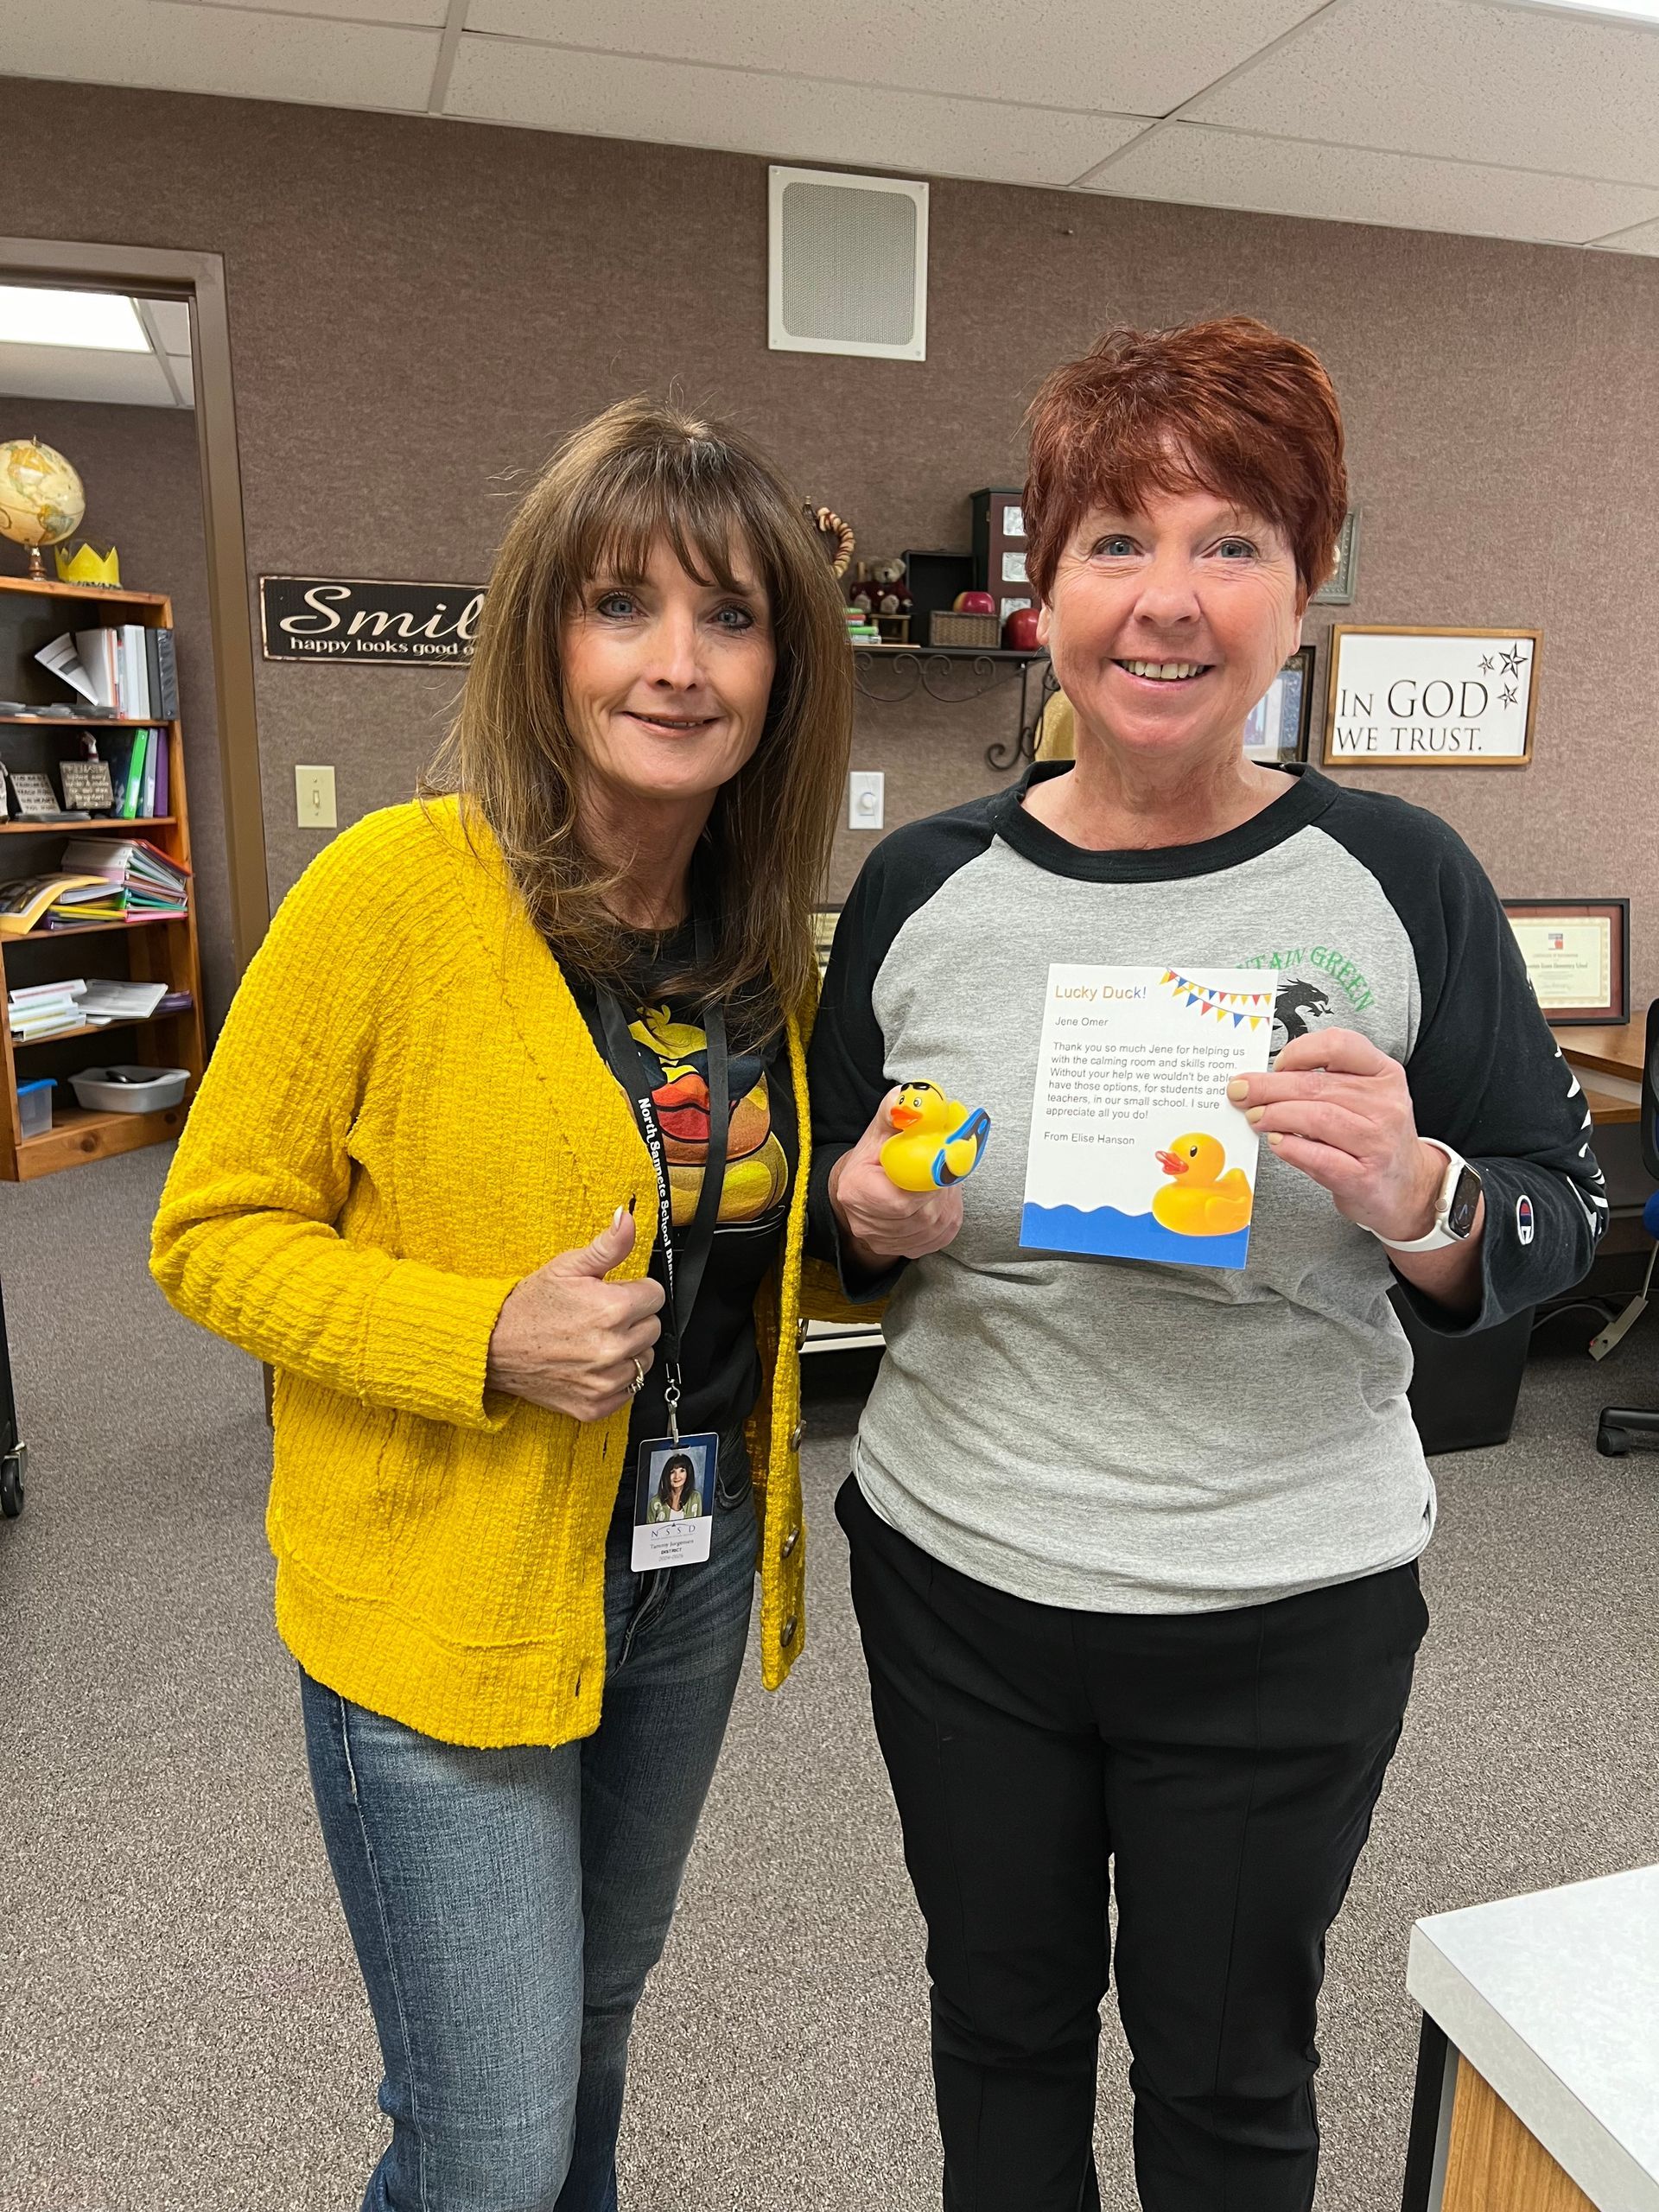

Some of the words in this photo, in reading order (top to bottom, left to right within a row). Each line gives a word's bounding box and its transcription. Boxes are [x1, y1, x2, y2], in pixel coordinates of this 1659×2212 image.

[279, 585, 485, 639] Smil
[290, 636, 352, 653] happy
[356, 639, 409, 653] looks
[412, 642, 458, 657] good
[1339, 689, 1375, 718] IN
[1388, 679, 1489, 719] GOD
[1337, 727, 1379, 752] WE
[1390, 727, 1483, 753] TRUST.
[1310, 945, 1376, 1013] GREEN
[1055, 985, 1098, 1002] Lucky
[1102, 985, 1147, 1000] Duck!
[1054, 1017, 1078, 1027] Jene
[1081, 1017, 1109, 1027] Omer
[1053, 1041, 1083, 1052] Thank
[1084, 1044, 1103, 1054] you
[1119, 1044, 1147, 1053] much
[1148, 1044, 1173, 1054] Jene
[1176, 1045, 1190, 1055] for
[1192, 1046, 1230, 1058] helping
[1051, 1055, 1071, 1064] with
[1073, 1055, 1088, 1065] the
[1090, 1056, 1128, 1068] calming
[1130, 1058, 1156, 1067] room
[1158, 1058, 1178, 1068] and
[1180, 1058, 1205, 1068] skills
[1208, 1061, 1237, 1070] room.
[1050, 1067, 1086, 1077] Without
[1089, 1071, 1110, 1080] your
[1112, 1070, 1133, 1080] help
[1153, 1071, 1194, 1081] wouldn't
[1197, 1072, 1210, 1082] be
[1048, 1079, 1071, 1090] have
[1074, 1080, 1101, 1090] those
[1103, 1082, 1141, 1092] options,
[1144, 1083, 1158, 1093] for
[1160, 1084, 1204, 1095] students
[1205, 1086, 1225, 1096] and
[1047, 1093, 1090, 1105] teachers,
[1093, 1094, 1103, 1103] in
[1104, 1096, 1122, 1105] our
[1123, 1096, 1150, 1106] small
[1197, 1101, 1220, 1109] sure
[1046, 1106, 1096, 1117] appreciate
[1097, 1108, 1109, 1117] all
[1112, 1110, 1130, 1121] you
[1132, 1109, 1148, 1120] do!
[1044, 1131, 1069, 1141] From
[1071, 1133, 1095, 1143] Elise
[1097, 1134, 1135, 1145] Hanson
[638, 1097, 658, 1144] North
[660, 1199, 672, 1248] School
